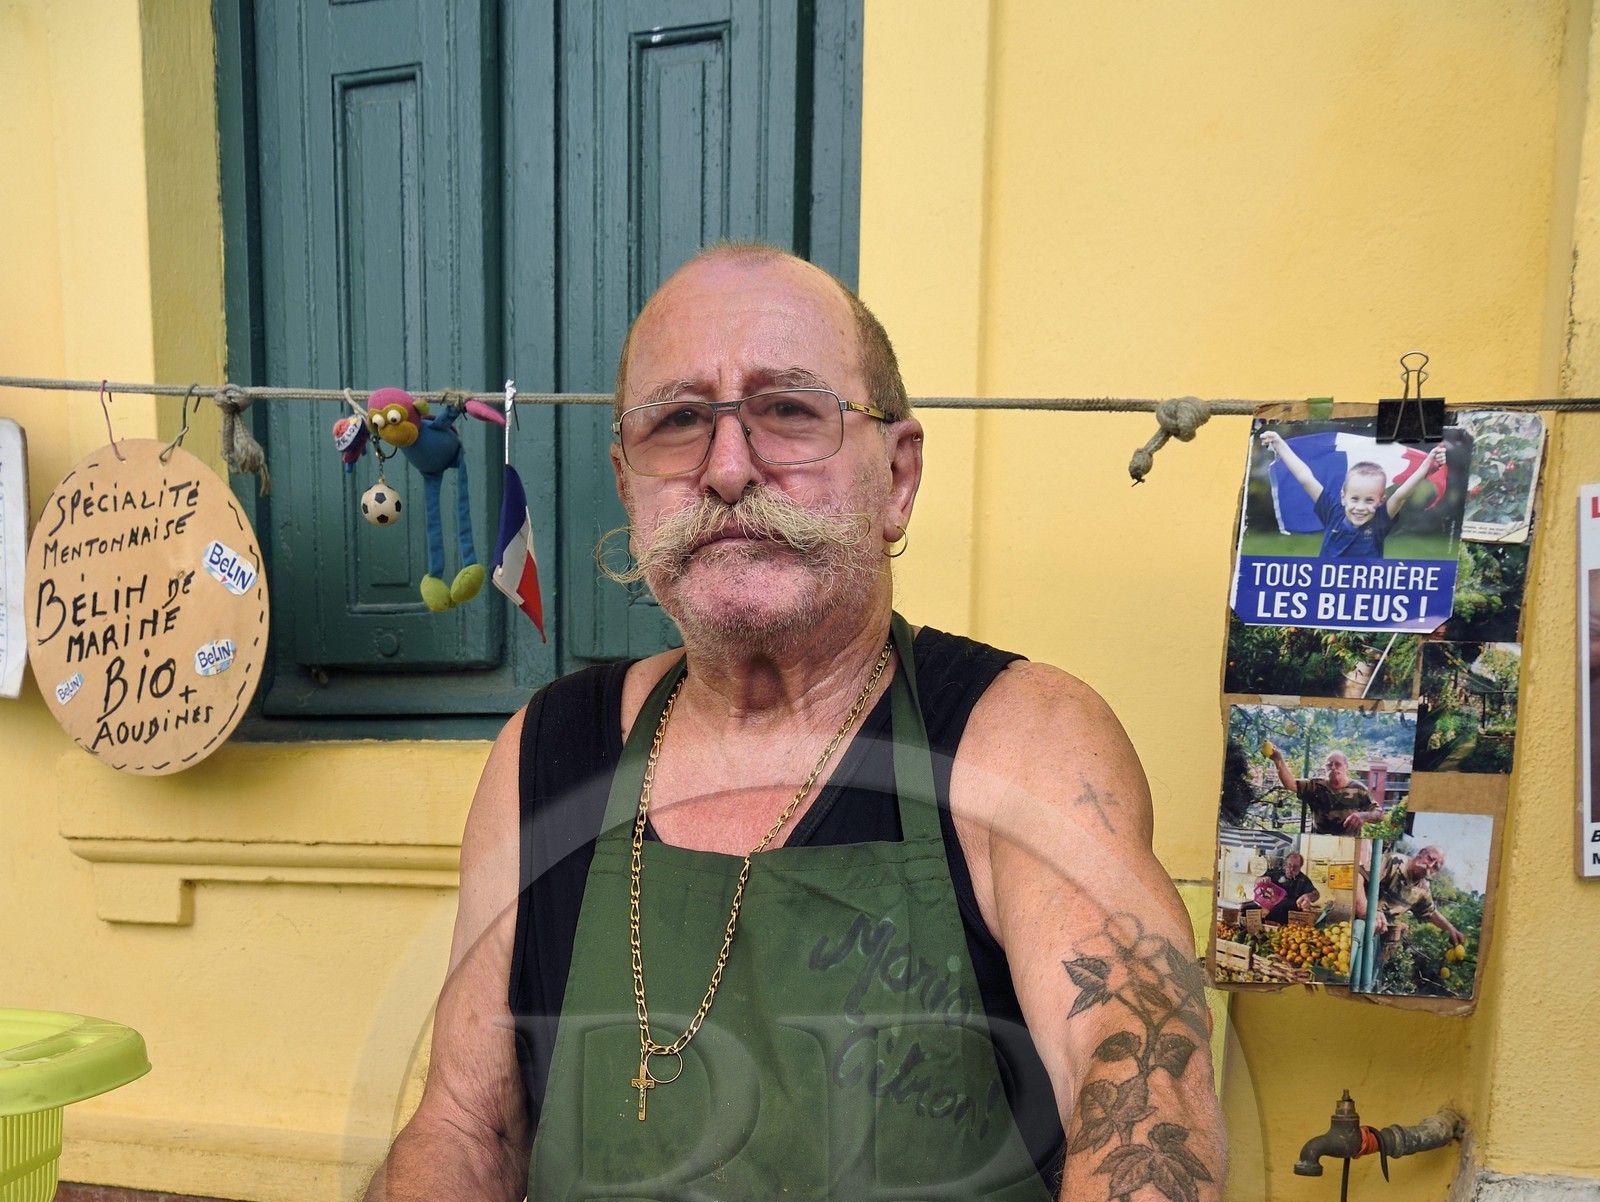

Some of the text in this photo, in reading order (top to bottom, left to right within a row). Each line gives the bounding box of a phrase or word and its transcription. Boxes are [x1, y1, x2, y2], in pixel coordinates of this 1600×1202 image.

[1251, 561, 1441, 591] TOUS DERRIÈRE
[1256, 590, 1309, 619] LES
[1317, 592, 1410, 623] BLEUS
